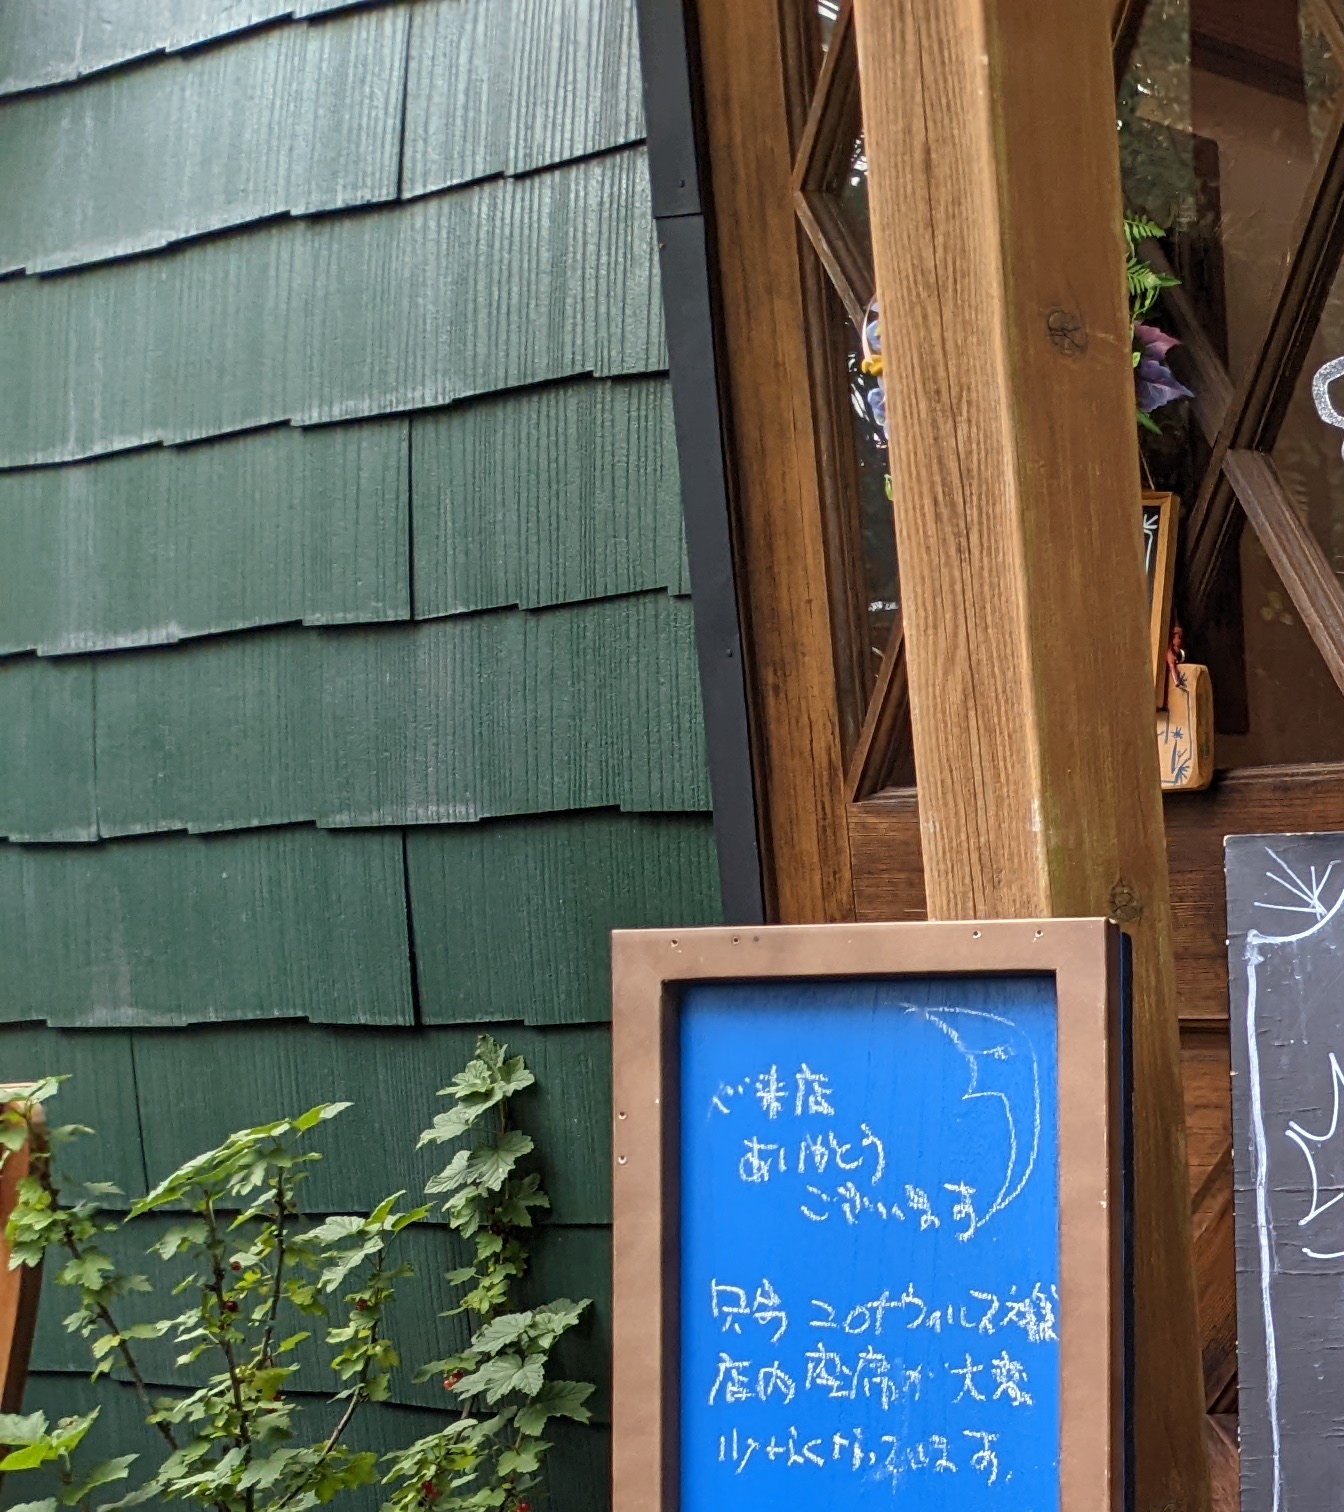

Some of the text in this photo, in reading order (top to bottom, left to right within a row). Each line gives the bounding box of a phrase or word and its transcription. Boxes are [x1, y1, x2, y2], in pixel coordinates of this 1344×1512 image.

[738, 1122, 886, 1186] ありがとう
[800, 1180, 977, 1243] ございます
